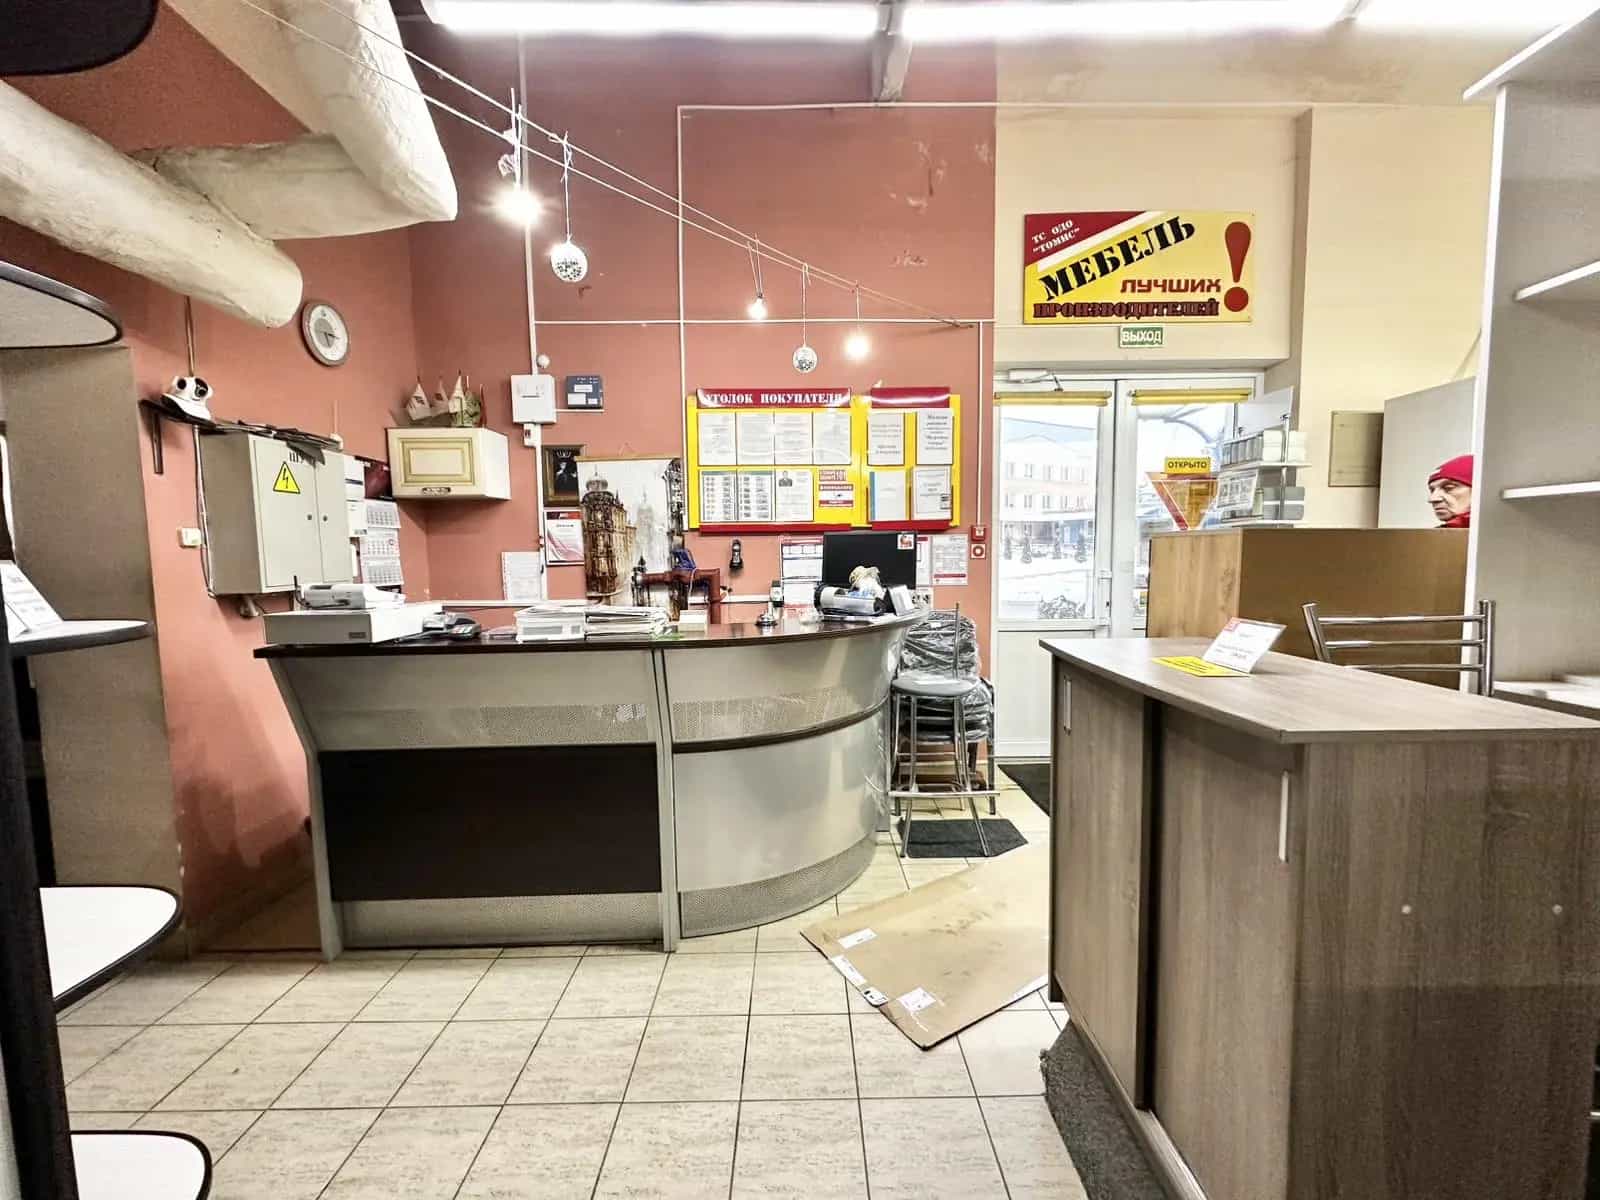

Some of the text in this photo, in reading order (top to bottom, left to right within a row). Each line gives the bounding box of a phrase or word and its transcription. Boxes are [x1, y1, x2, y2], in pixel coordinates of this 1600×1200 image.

[1032, 231, 1046, 244] ТС
[1039, 216, 1195, 301] МЕБЕЛЬ
[1120, 278, 1221, 293] ЛУЧШИХ
[1033, 298, 1219, 320] ПРОИЗВОДИТЕЛЕЙ
[1122, 329, 1162, 342] ВЫХОД
[1167, 461, 1208, 469] ОТКРЫТО
